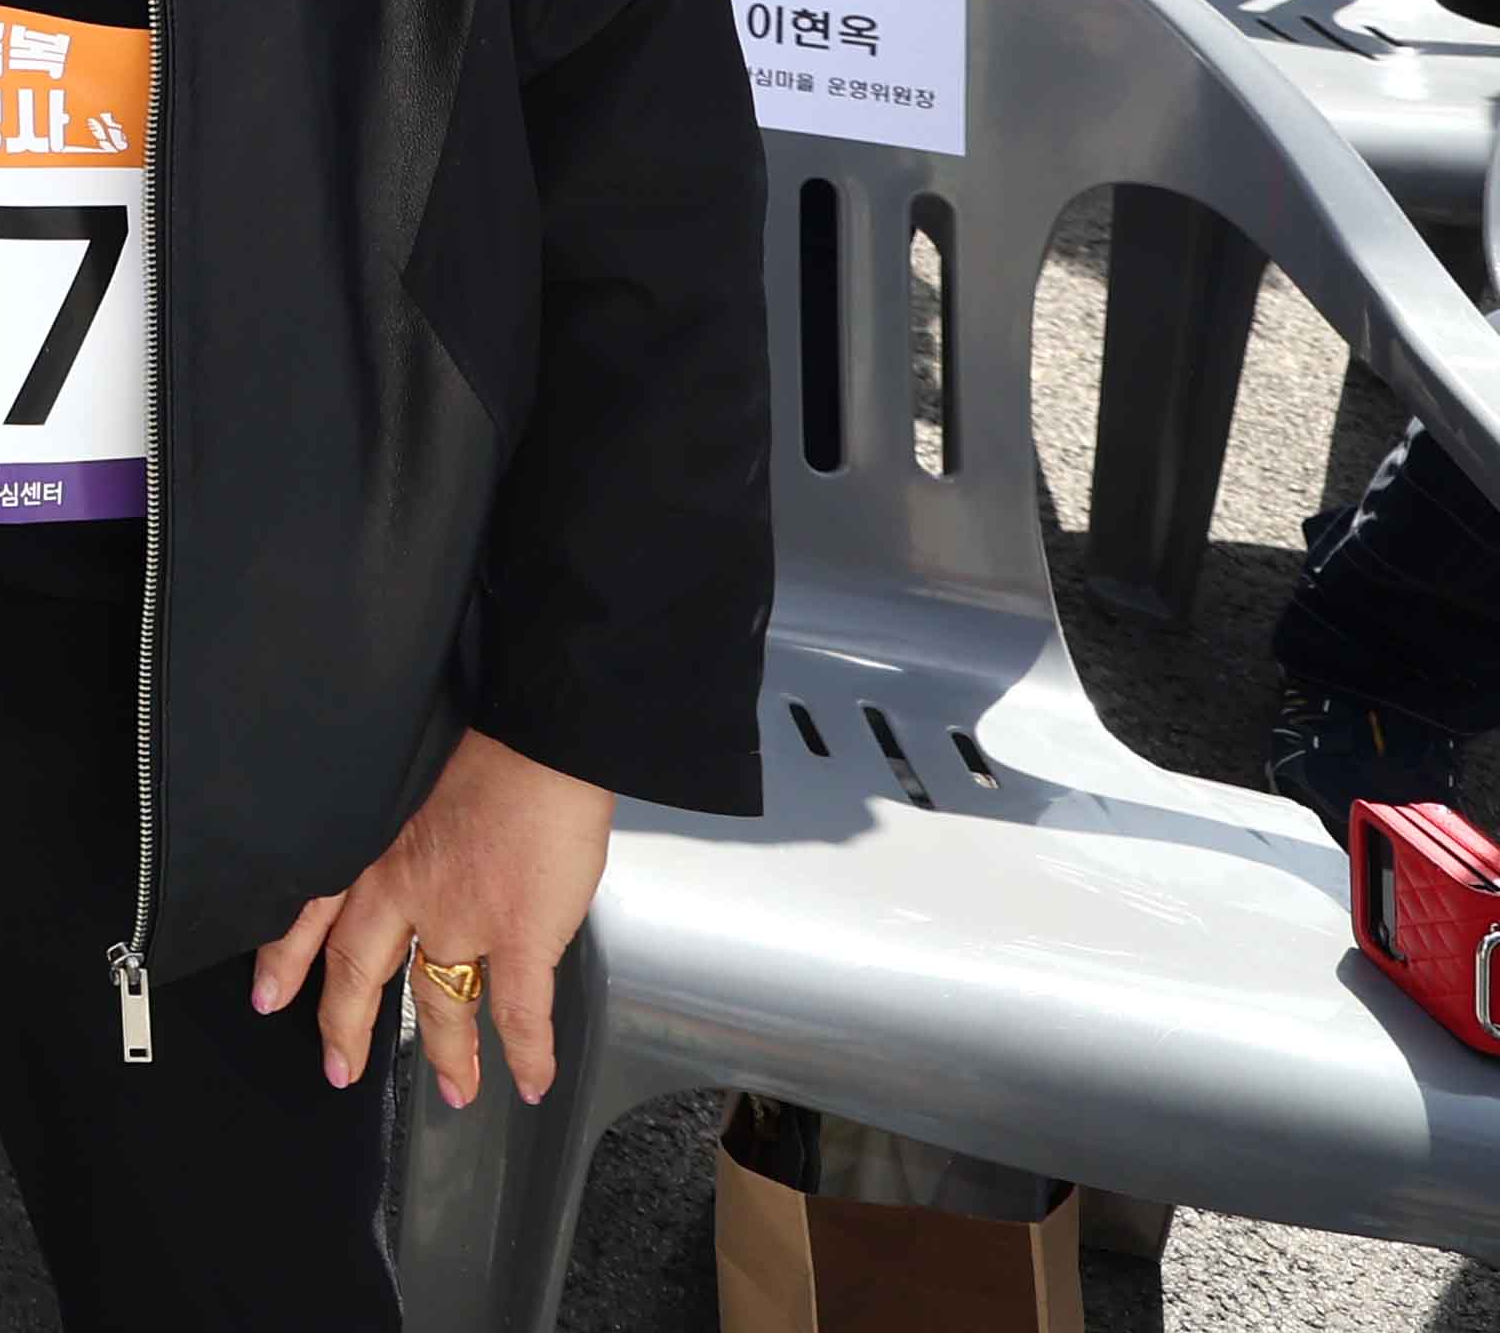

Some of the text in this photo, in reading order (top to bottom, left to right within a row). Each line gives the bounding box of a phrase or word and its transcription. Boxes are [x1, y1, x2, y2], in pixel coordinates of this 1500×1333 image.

[747, 3, 880, 57] 이현옥
[748, 66, 937, 110] 심마을 운영위원장
